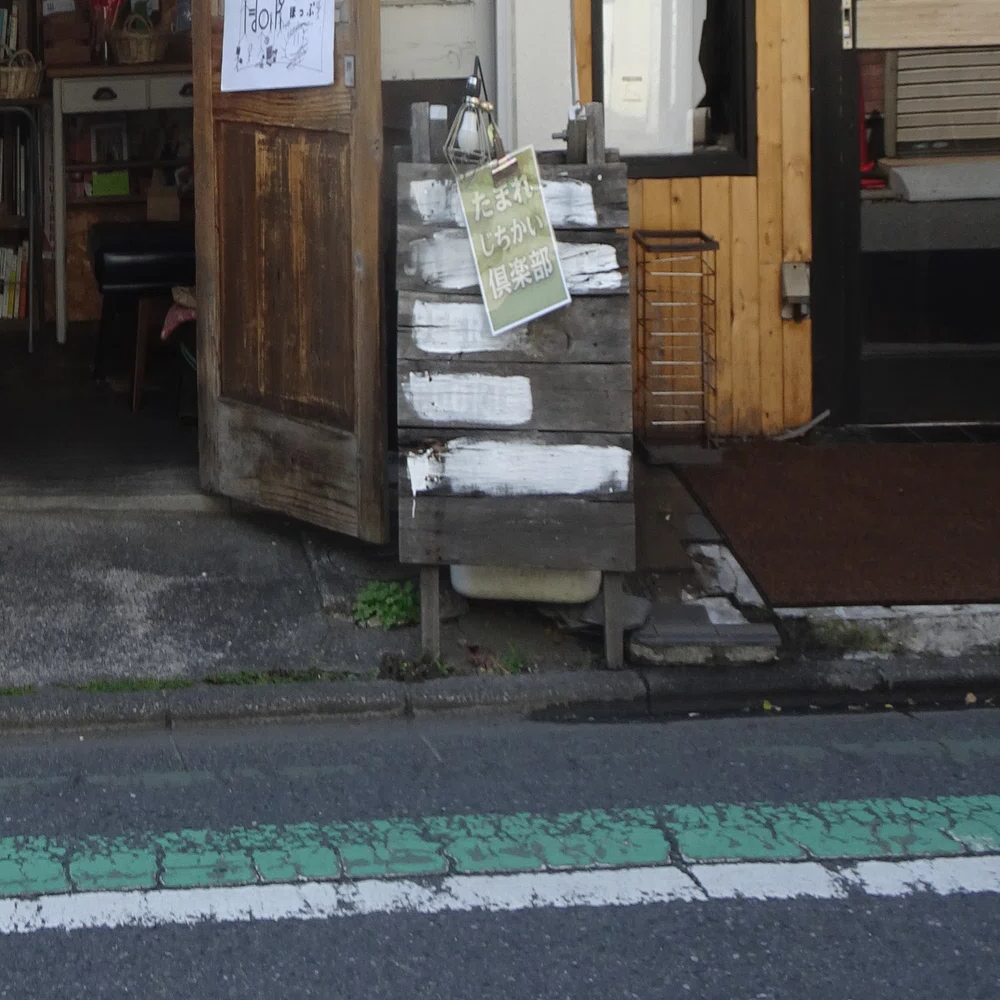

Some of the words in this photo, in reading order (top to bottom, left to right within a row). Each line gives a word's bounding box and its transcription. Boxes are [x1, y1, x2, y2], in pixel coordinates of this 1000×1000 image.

[471, 174, 541, 222] たまれ
[479, 213, 545, 258] じちかい
[488, 246, 555, 300] 倶楽部
